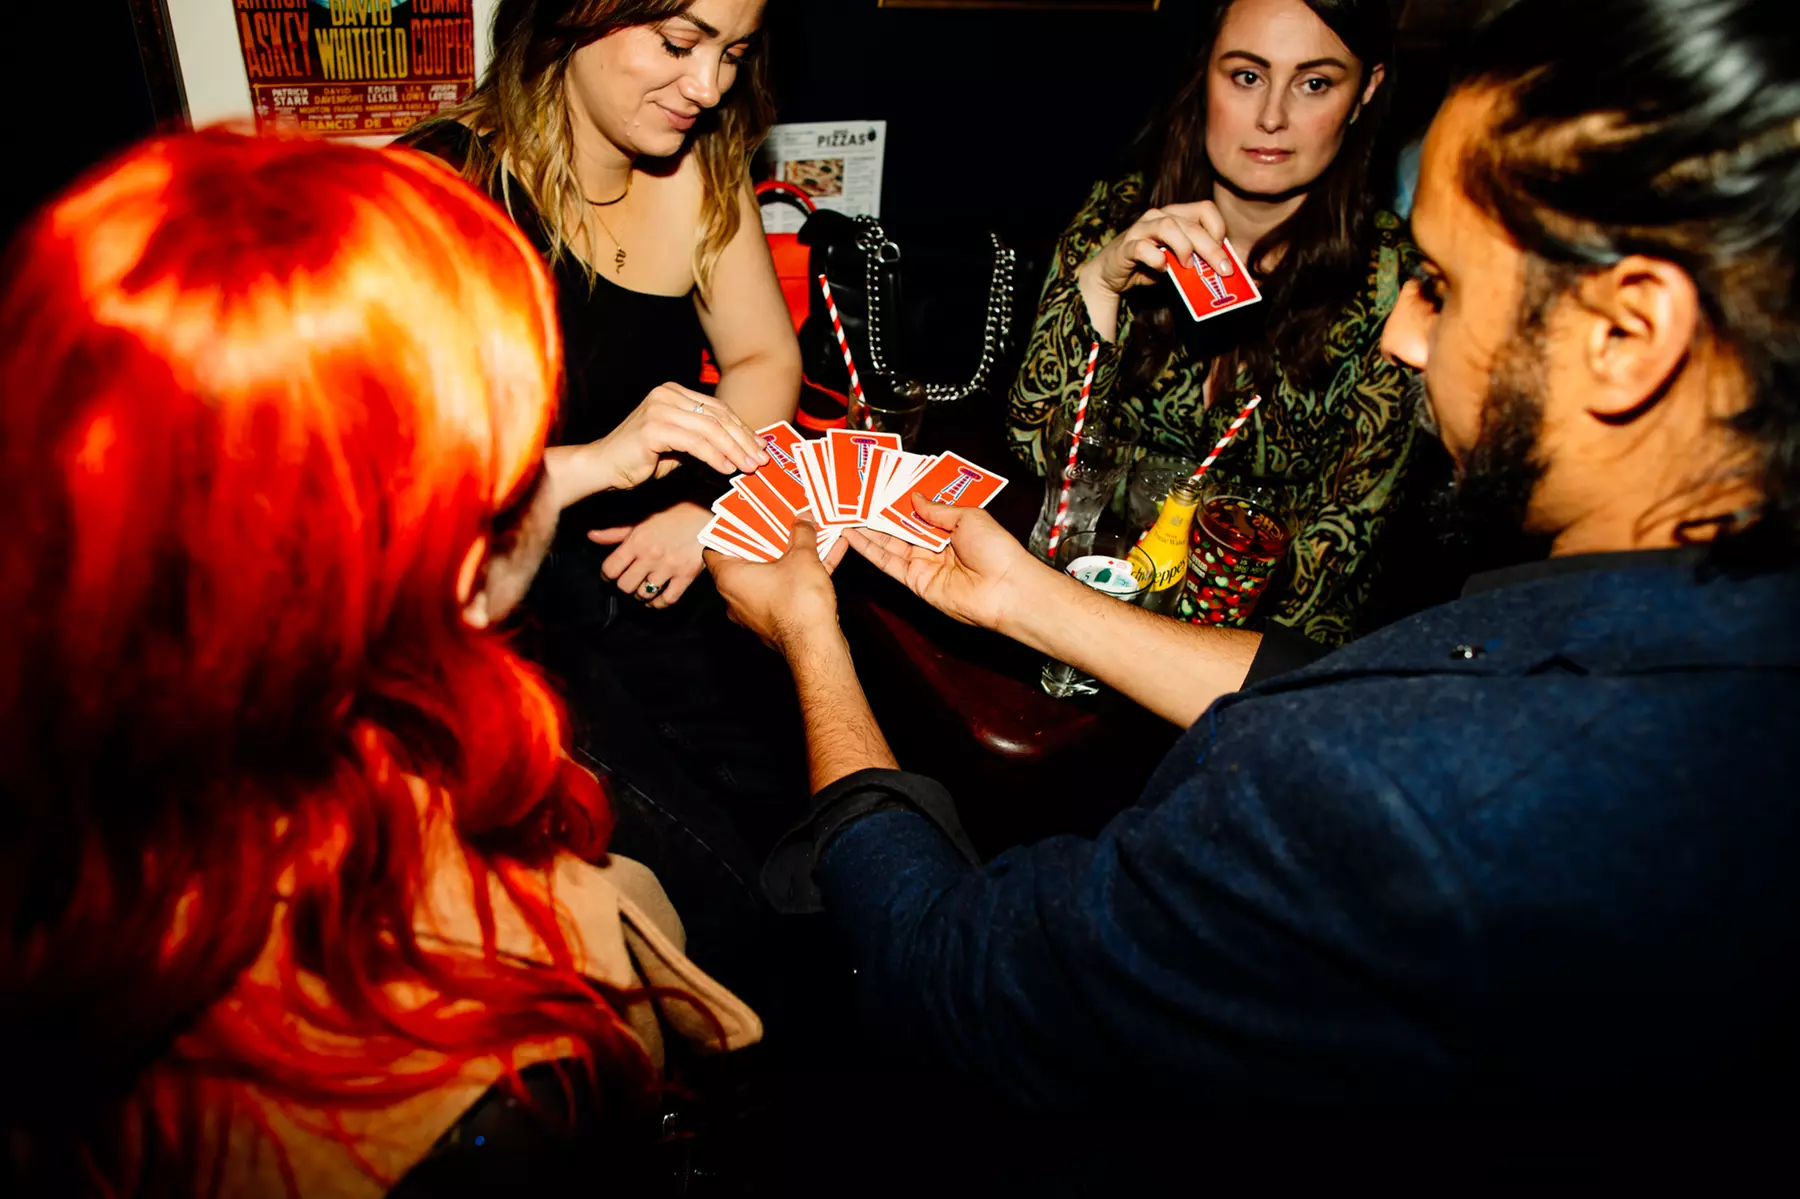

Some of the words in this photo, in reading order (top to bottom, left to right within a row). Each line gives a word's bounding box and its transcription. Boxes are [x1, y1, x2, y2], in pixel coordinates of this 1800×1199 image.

[240, 11, 312, 78] ASKEY
[410, 17, 474, 76] COOPER
[314, 28, 409, 80] WHITFIELD
[273, 96, 310, 106] STARK
[313, 94, 364, 105] DAVENPORT
[367, 93, 399, 103] LESLIE
[300, 119, 357, 130] FRANCIS
[364, 118, 383, 128] DE
[817, 133, 867, 148] PIZZAS
